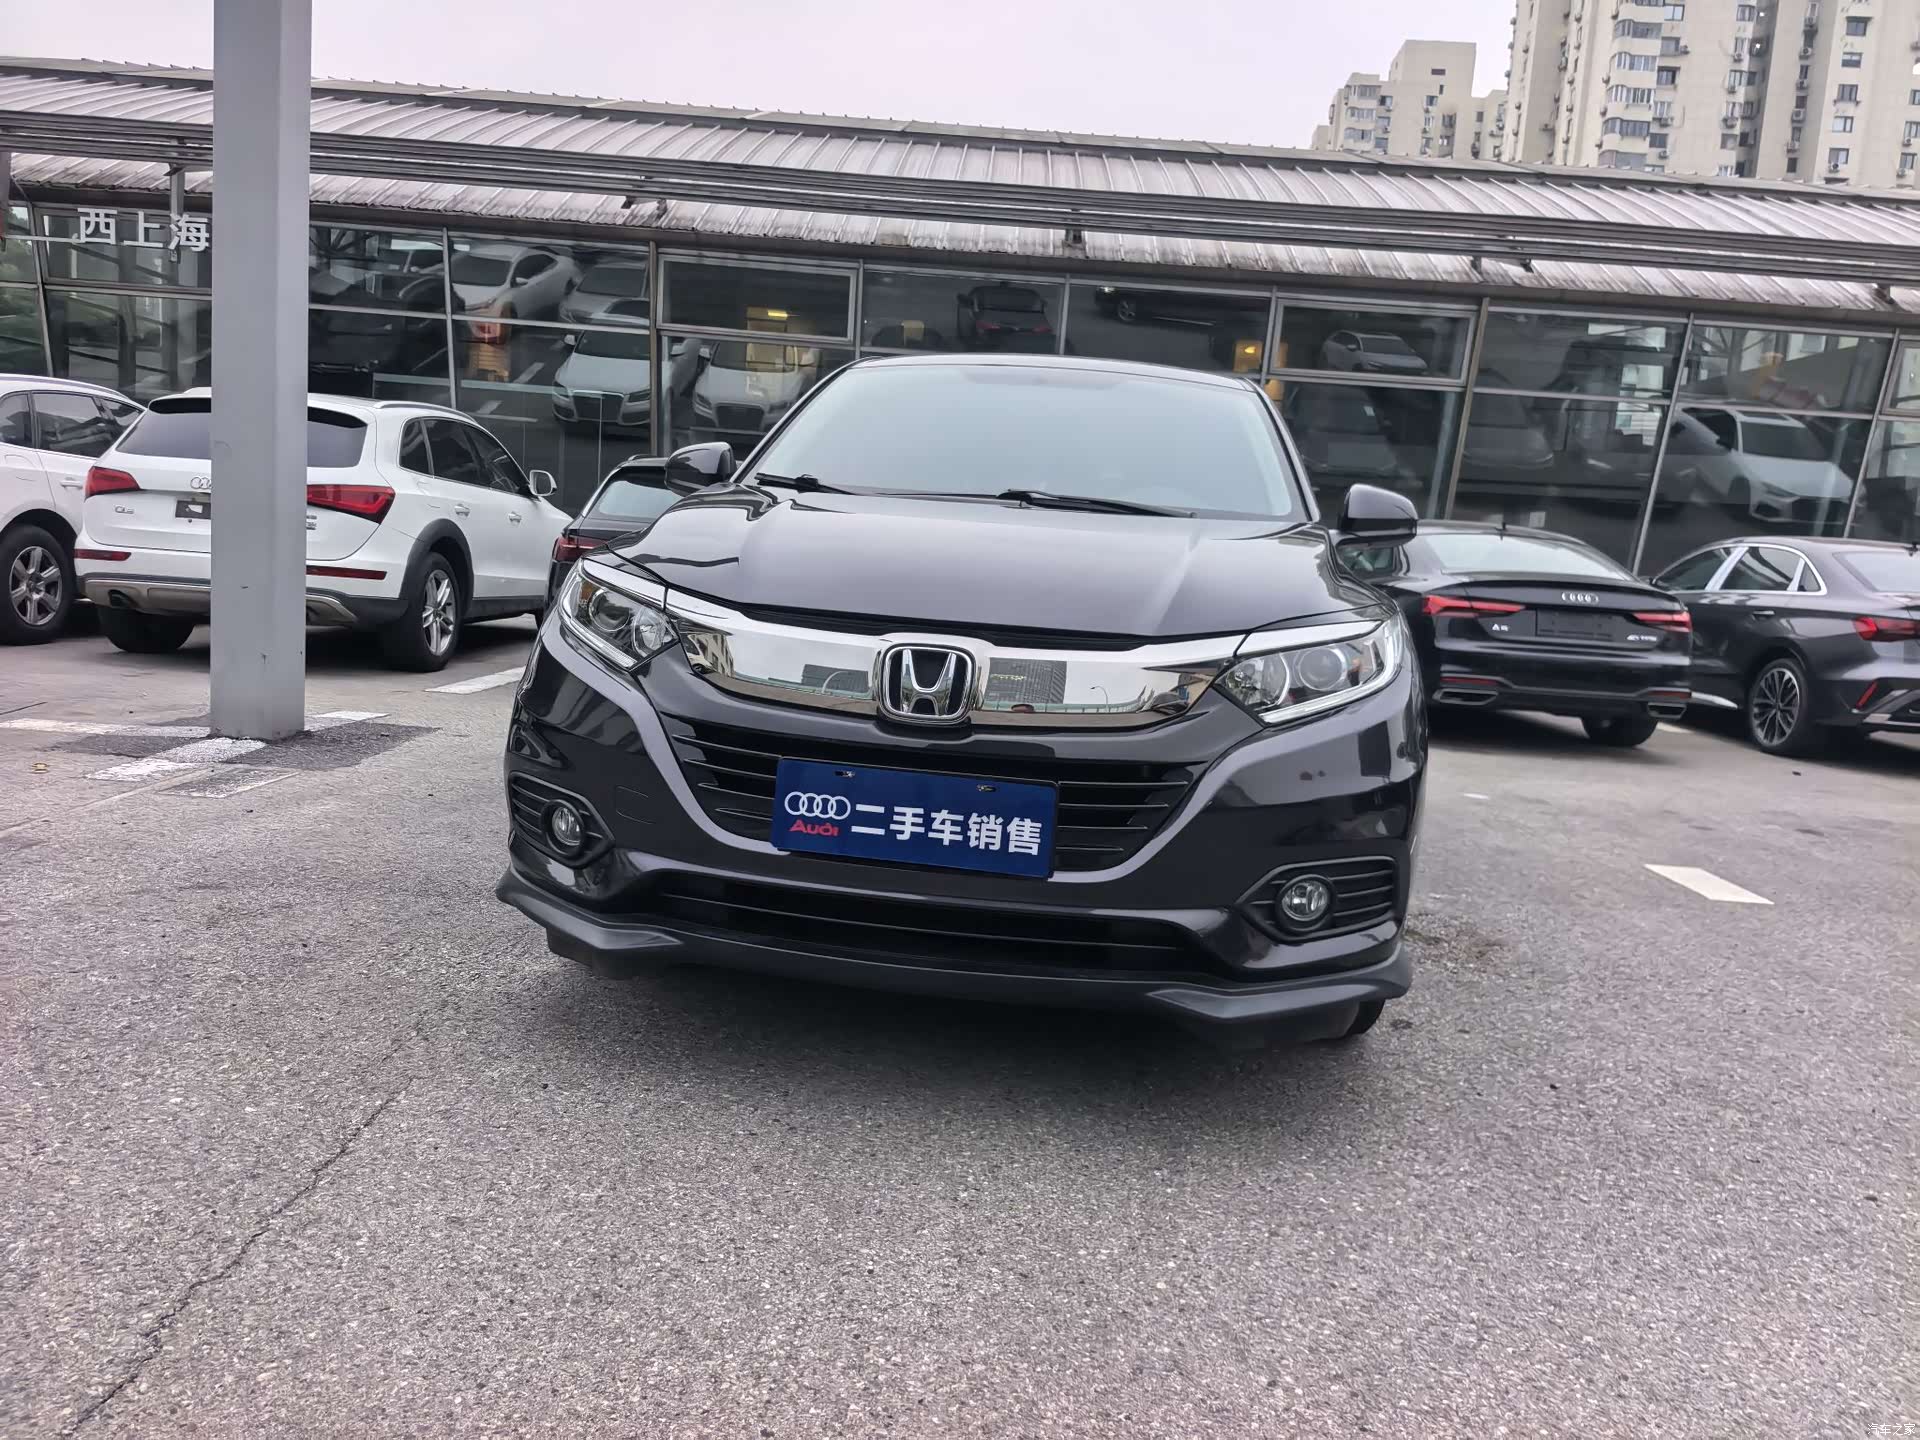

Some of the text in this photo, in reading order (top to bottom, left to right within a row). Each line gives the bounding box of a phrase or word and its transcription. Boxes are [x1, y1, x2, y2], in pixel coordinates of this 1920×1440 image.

[78, 208, 209, 252] 西上海
[789, 820, 839, 837] Audi
[851, 804, 1042, 856] 二手车销售
